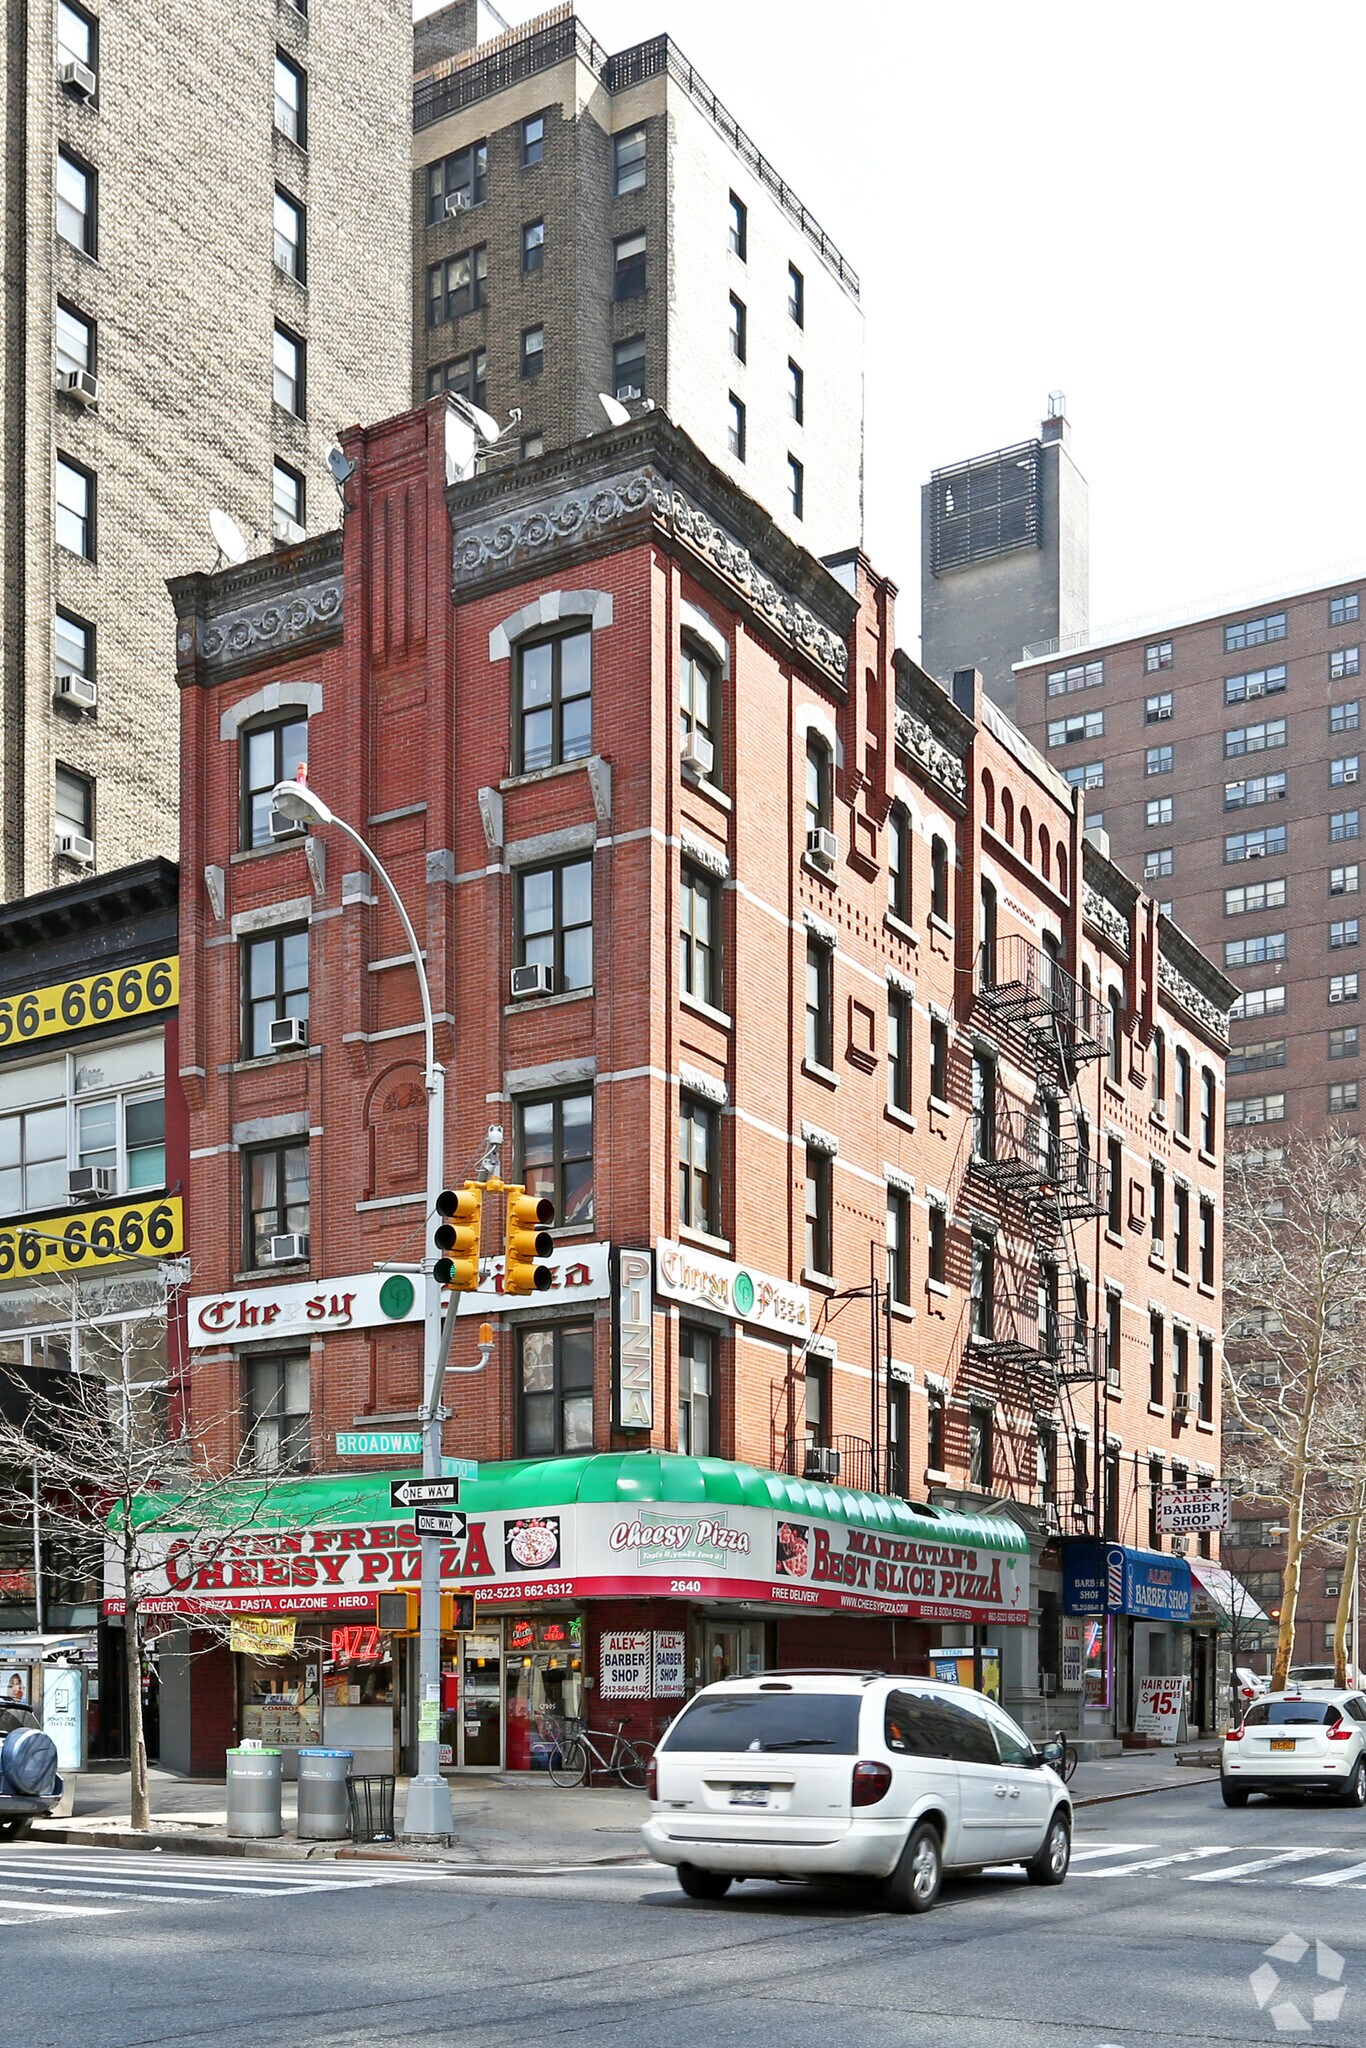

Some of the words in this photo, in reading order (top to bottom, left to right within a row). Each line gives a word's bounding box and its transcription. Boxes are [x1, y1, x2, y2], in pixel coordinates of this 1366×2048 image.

[756, 1280, 807, 1326] Pizza
[622, 1255, 650, 1425] PIZZA
[336, 1436, 420, 1452] BROADWAY
[452, 1460, 467, 1477] 100
[402, 1487, 423, 1499] ONE
[427, 1486, 449, 1497] WAY
[1172, 1494, 1212, 1504] ALEX
[1163, 1503, 1220, 1515] BARBER
[420, 1517, 435, 1528] ONE
[438, 1519, 453, 1530] WAY
[1172, 1515, 1211, 1526] SHOP
[310, 1524, 456, 1552] FRES
[609, 1520, 694, 1551] Cheesy
[695, 1520, 751, 1555] Pizza
[847, 1529, 978, 1571] MANHATTAN'S
[166, 1538, 350, 1591] CHEESY
[811, 1527, 871, 1588] BEST
[874, 1559, 935, 1597] SLICE
[938, 1558, 1003, 1604] PIZZA
[670, 1580, 702, 1592] 2640
[1074, 1578, 1105, 1588] BARBR
[107, 1602, 126, 1613] FRE
[240, 1598, 271, 1609] PASTA
[279, 1597, 328, 1609] CALZONE
[338, 1595, 368, 1607] HERO
[474, 1586, 522, 1600] 662-5223
[524, 1583, 573, 1596] 662-6312
[772, 1587, 788, 1599] FREE
[789, 1589, 819, 1603] DELIVERY
[840, 1595, 908, 1614] WWW.CHEESYPIZZA.COM
[920, 1605, 933, 1616] BEER
[934, 1607, 938, 1616] &
[939, 1606, 952, 1618] SODA
[952, 1608, 972, 1620] SERVED
[1135, 1584, 1167, 1608] BARBER
[1168, 1589, 1189, 1610] SHOP
[261, 1619, 294, 1636] Online
[610, 1638, 636, 1650] ALEX
[660, 1636, 676, 1649] ALEX
[605, 1653, 645, 1666] BARBER
[657, 1652, 682, 1665] BARBER
[308, 1666, 315, 1677] A
[612, 1669, 639, 1682] SHOP
[660, 1669, 678, 1681] SHOP
[1064, 1664, 1080, 1680] SHOP
[1141, 1679, 1162, 1690] HAIR
[1164, 1679, 1182, 1690] CUT
